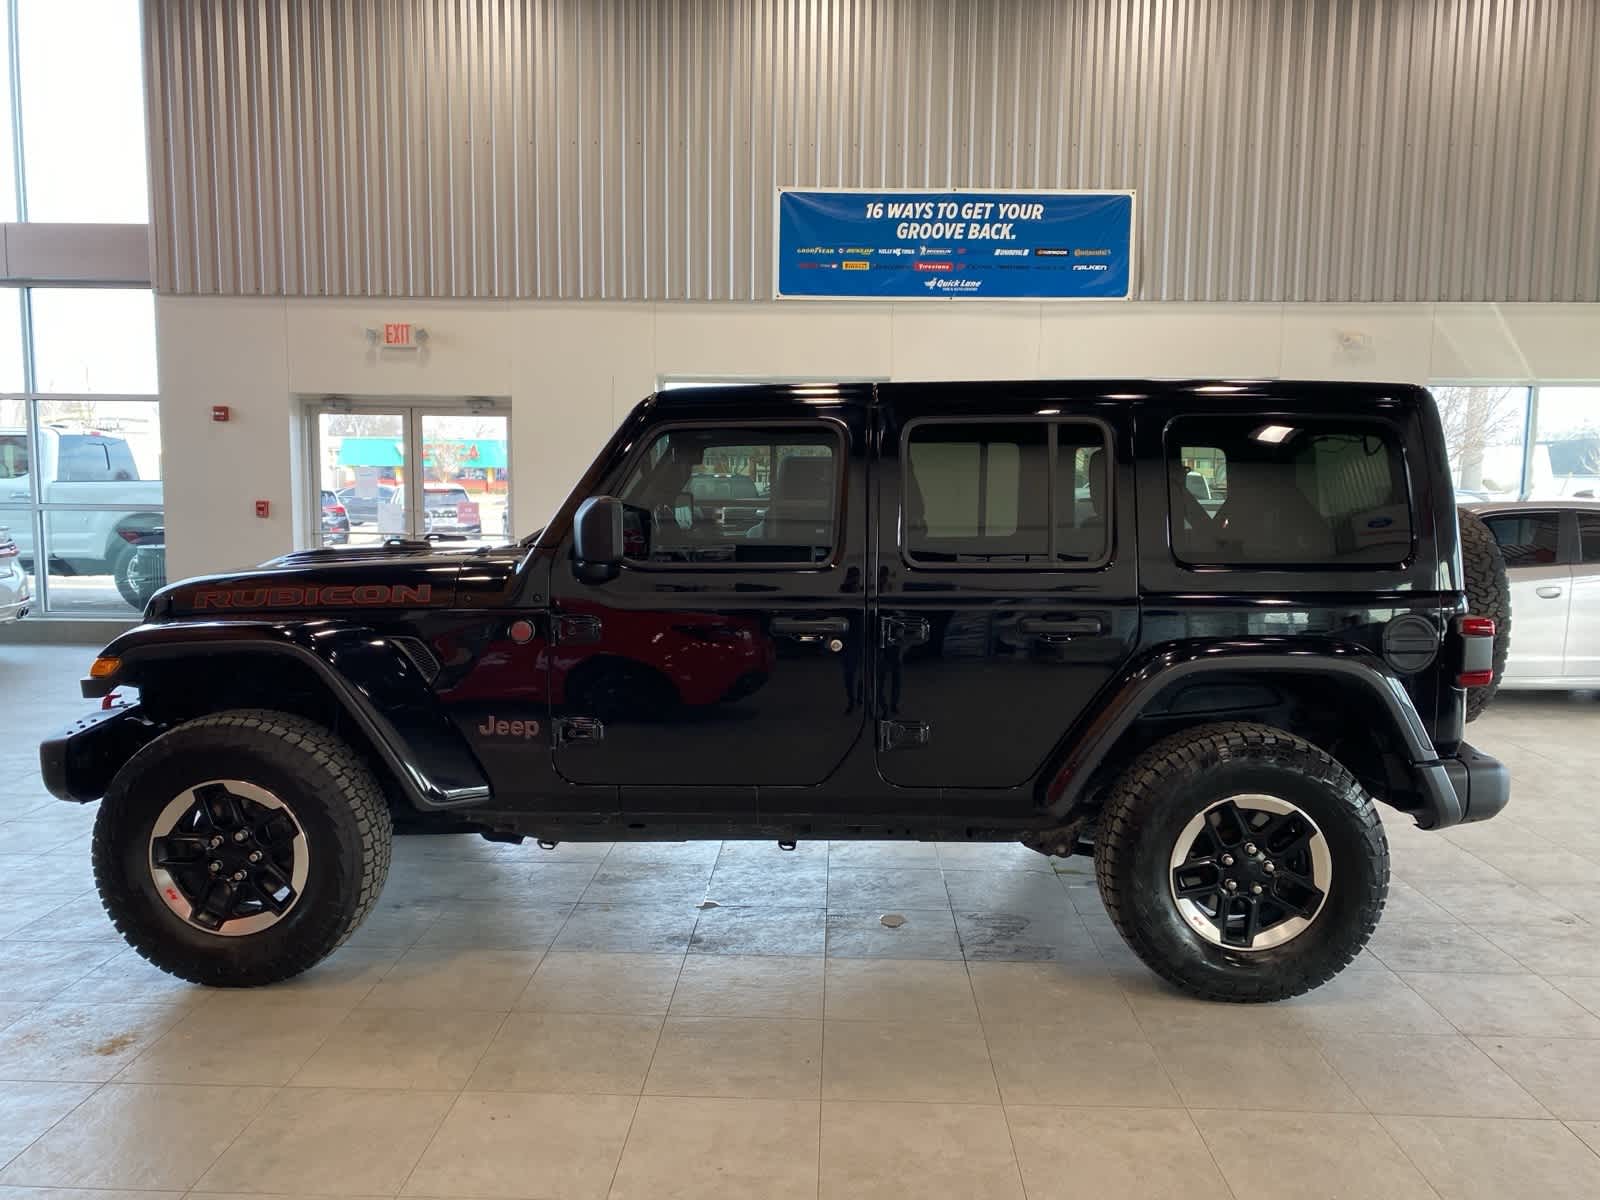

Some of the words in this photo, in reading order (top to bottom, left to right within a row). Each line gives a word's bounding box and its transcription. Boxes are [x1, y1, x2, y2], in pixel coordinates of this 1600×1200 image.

[866, 203, 883, 219] 16
[887, 203, 935, 220] WAYS
[937, 203, 959, 219] TO
[961, 203, 995, 220] GET
[998, 203, 1045, 220] YOUR
[896, 222, 965, 240] GROOVE
[967, 223, 1017, 240] BACK.
[936, 279, 961, 288] Quick
[960, 279, 982, 287] Lane
[385, 323, 411, 344] EXIT
[193, 584, 432, 609] RUBICON
[479, 715, 540, 739] Jeep
